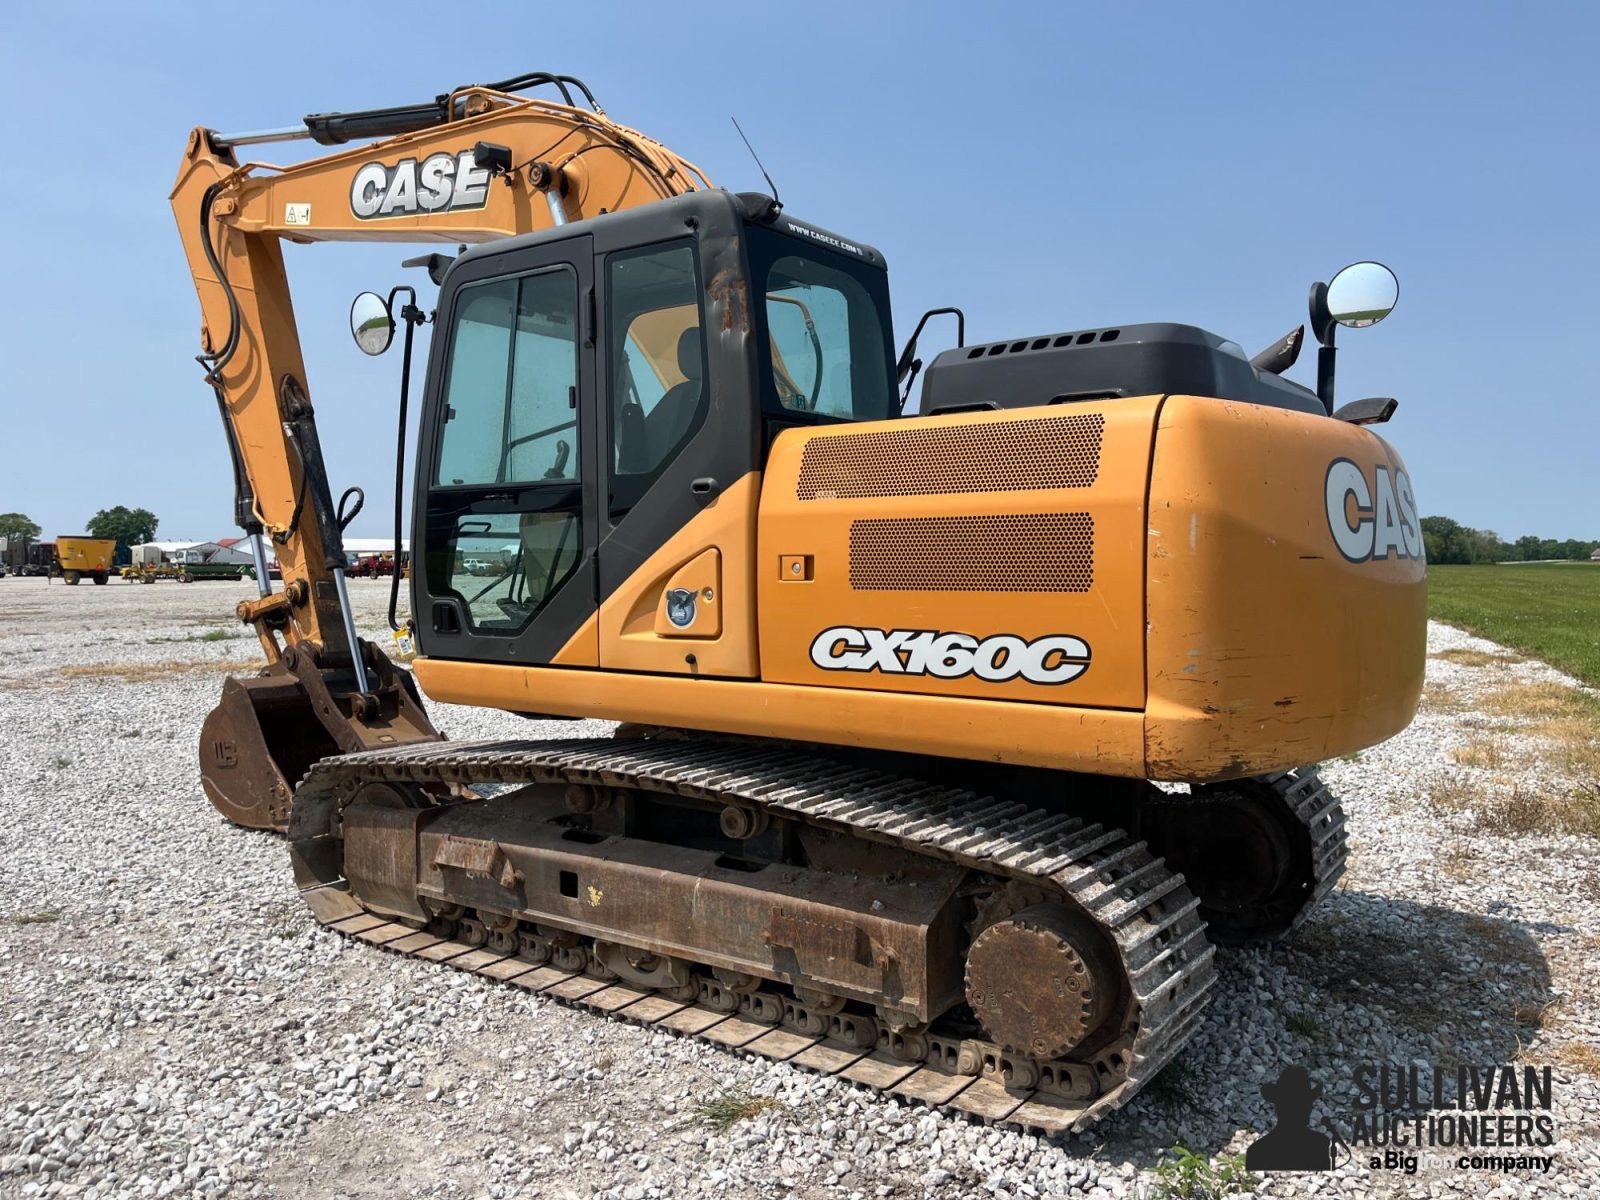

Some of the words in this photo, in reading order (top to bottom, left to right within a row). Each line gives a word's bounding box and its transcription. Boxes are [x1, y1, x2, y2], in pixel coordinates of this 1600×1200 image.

[350, 152, 491, 218] CASE
[1325, 457, 1426, 563] CAS
[810, 626, 1091, 685] CX160C
